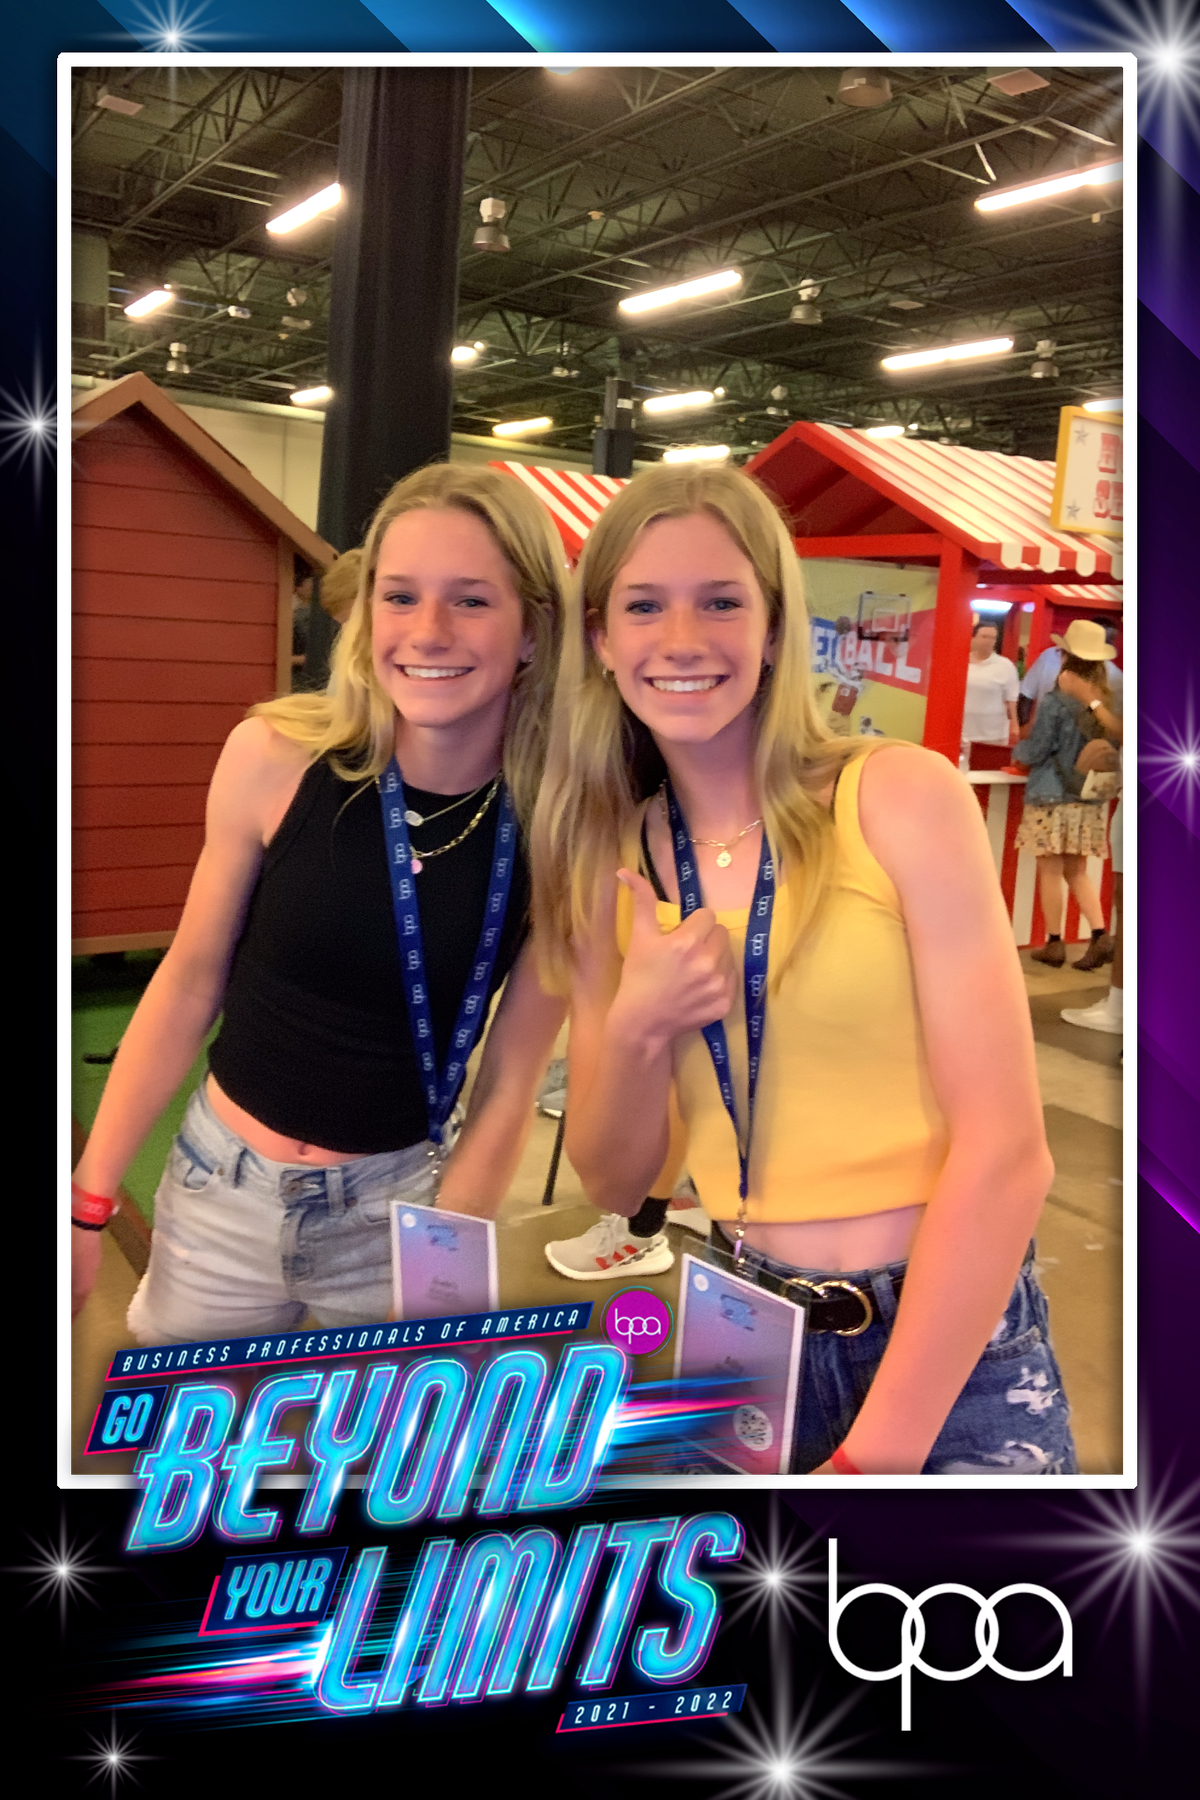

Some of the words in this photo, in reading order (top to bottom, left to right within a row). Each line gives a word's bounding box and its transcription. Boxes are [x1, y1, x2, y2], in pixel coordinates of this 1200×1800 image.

[389, 808, 404, 829] bpa
[394, 843, 410, 864] bpa
[398, 878, 415, 900] bpa
[756, 894, 773, 916] bpa
[403, 914, 418, 936] bpa
[750, 933, 767, 956] bpa
[407, 949, 422, 970] bpa
[412, 984, 426, 1004] bpa
